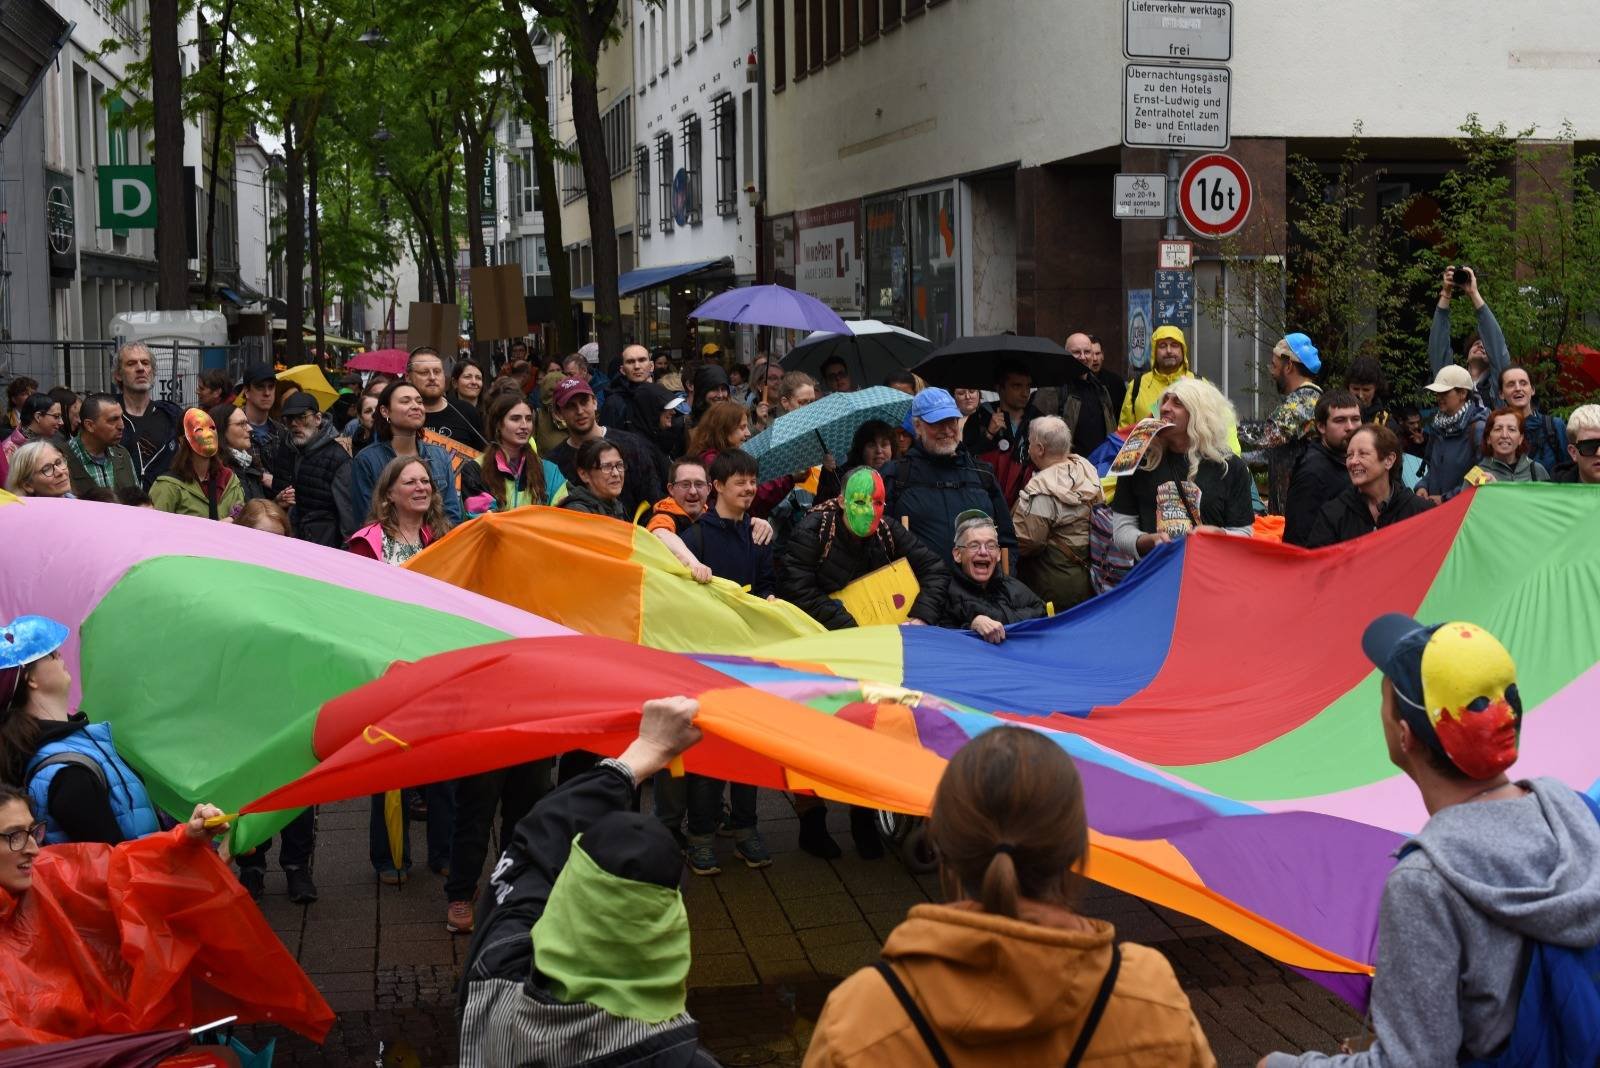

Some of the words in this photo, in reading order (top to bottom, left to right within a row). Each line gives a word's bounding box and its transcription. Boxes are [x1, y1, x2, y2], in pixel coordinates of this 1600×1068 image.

[1132, 1, 1185, 14] Lieferverkehr
[1190, 3, 1226, 18] werktags
[1169, 44, 1190, 56] frei
[1128, 67, 1228, 84] Übernachtungsgäste
[1144, 84, 1155, 92] zu
[1159, 83, 1177, 93] den
[1181, 84, 1212, 95] Hotels
[1133, 94, 1199, 109] Ernst-Ludwig
[1203, 97, 1221, 107] und
[1135, 106, 1195, 119] Zentralhotel
[1199, 111, 1219, 120] zum
[1134, 119, 1152, 130] Be-
[1156, 121, 1174, 131] und
[1178, 121, 1219, 132] Entladen
[1168, 133, 1186, 144] frei
[111, 178, 151, 218] D
